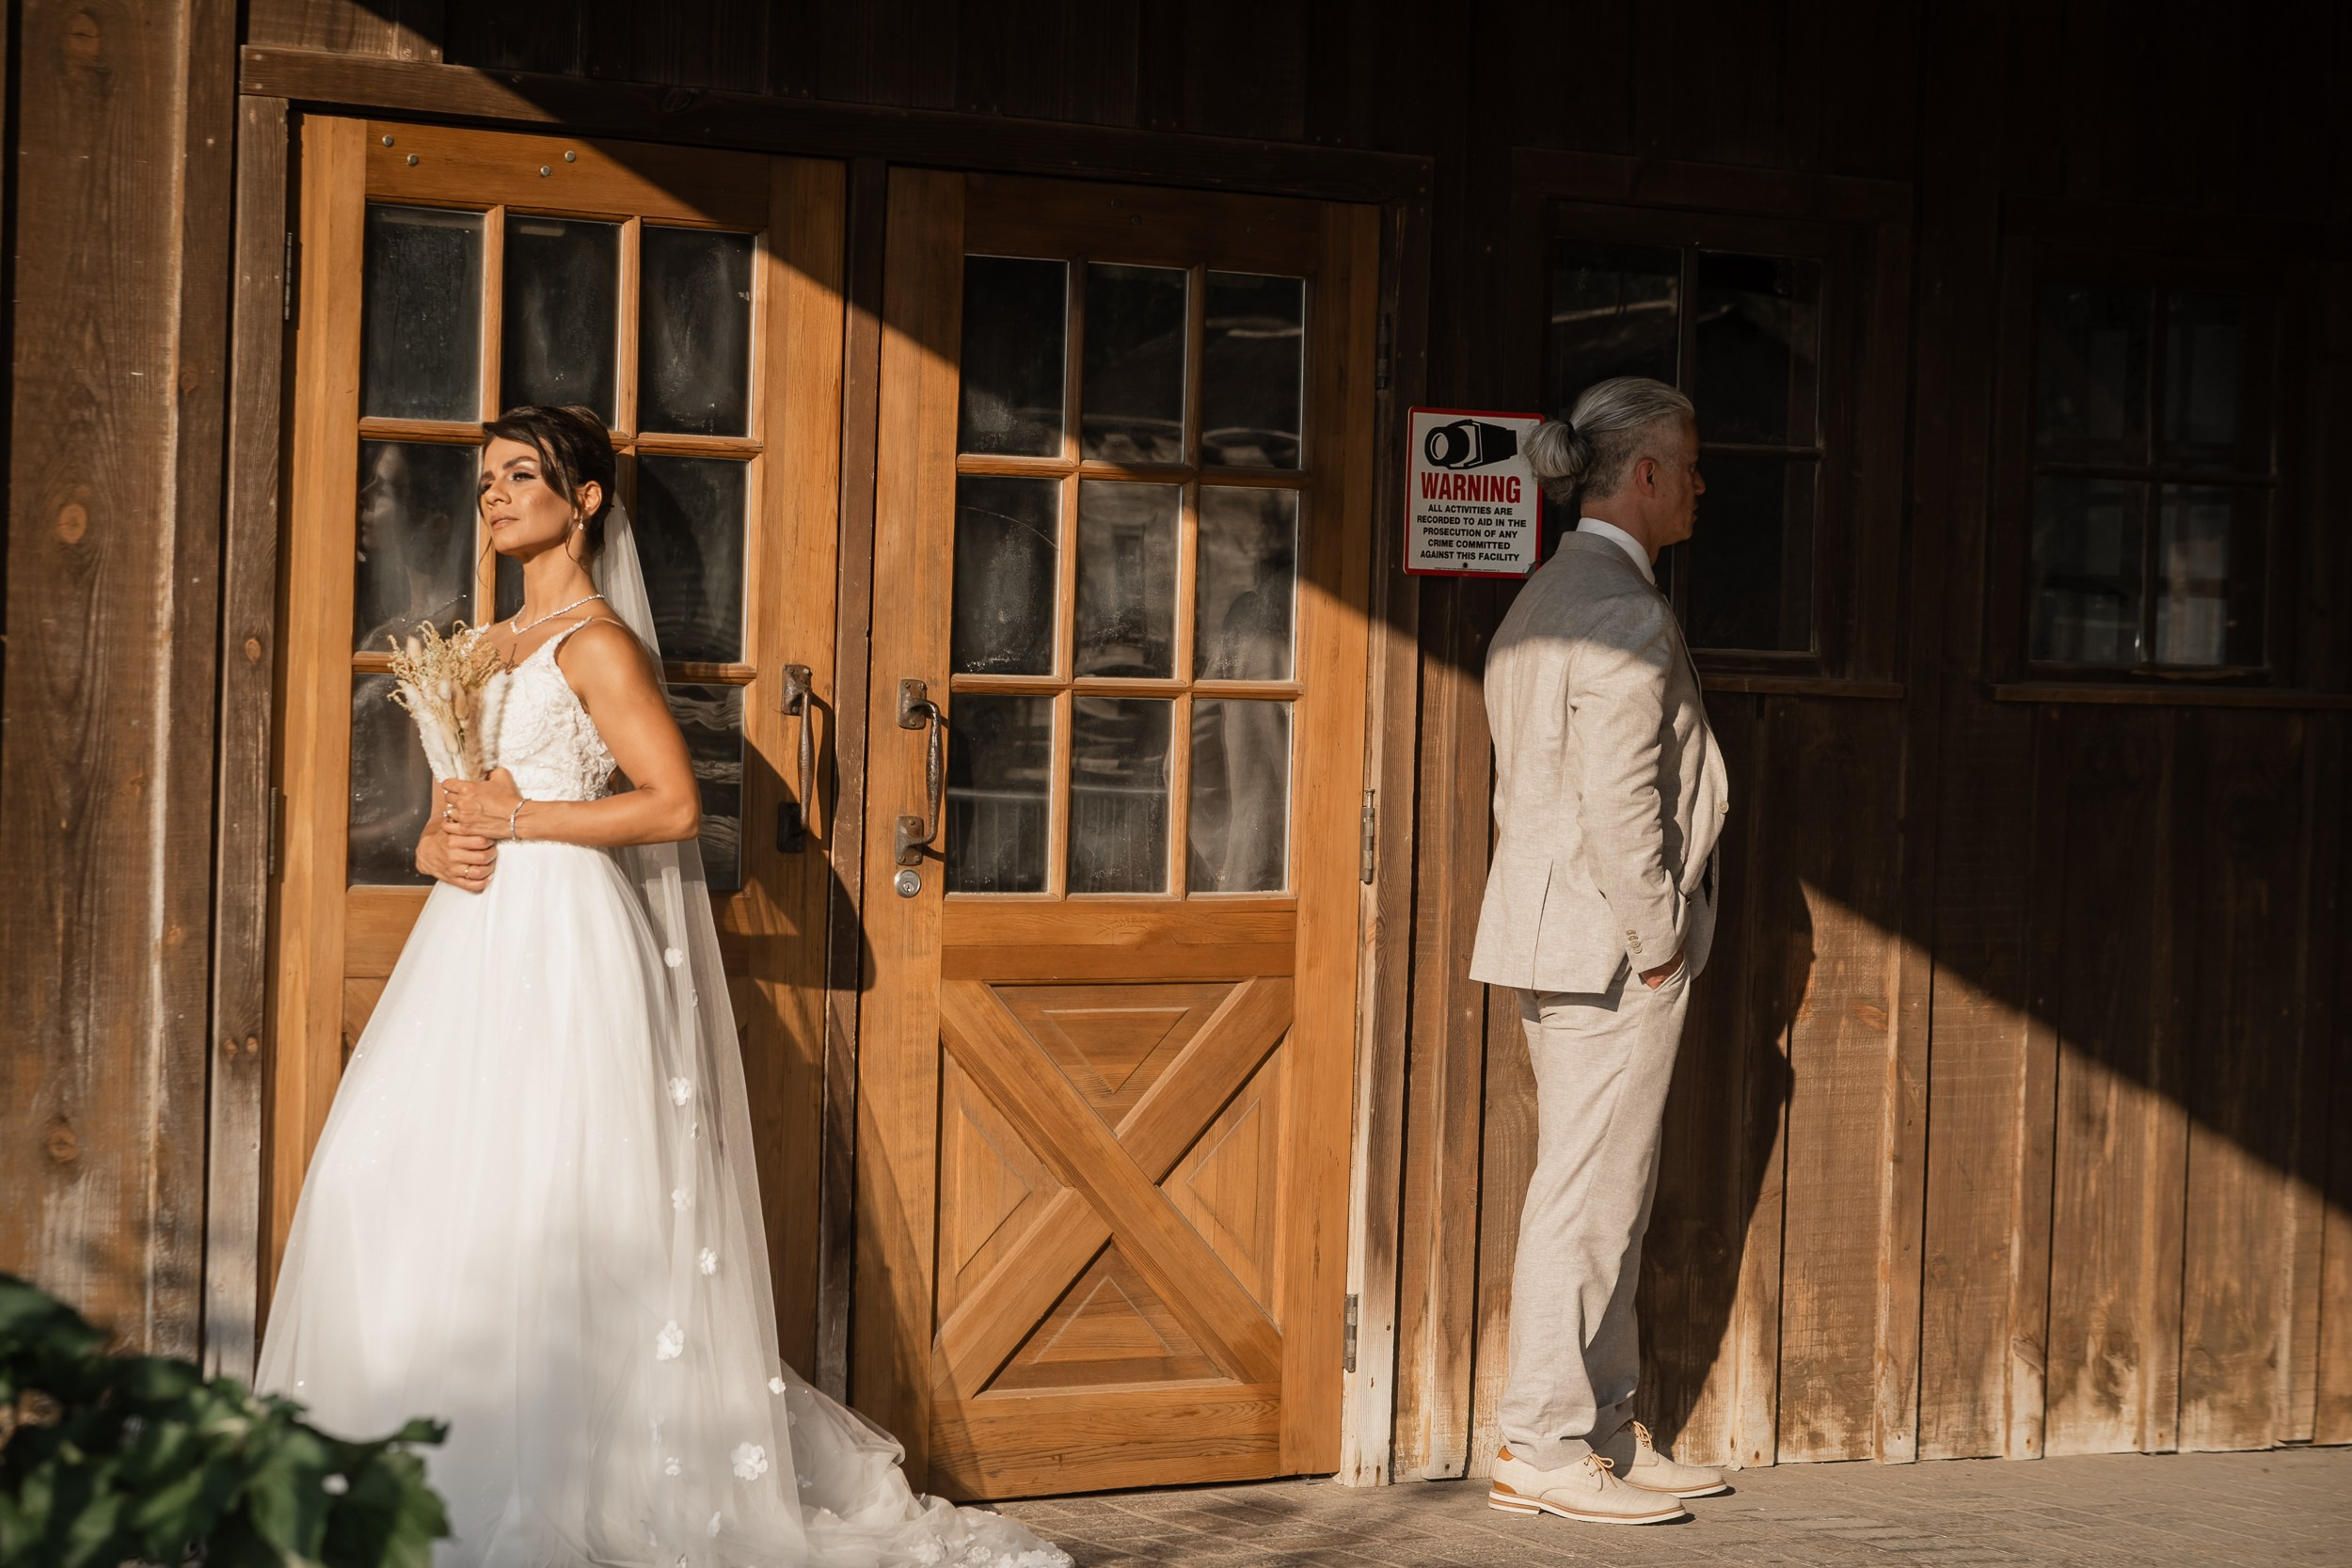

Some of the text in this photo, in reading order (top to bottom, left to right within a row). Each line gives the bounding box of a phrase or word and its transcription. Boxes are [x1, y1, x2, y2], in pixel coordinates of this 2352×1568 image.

[1421, 472, 1520, 503] WARNING
[1428, 504, 1442, 513] ALL
[1445, 505, 1491, 514] ACTIVITIES
[1417, 515, 1460, 524] RECORDED
[1423, 528, 1481, 536] PROSECUTION
[1428, 539, 1510, 549] CRIME COMMITTED
[1421, 551, 1454, 560] AGAINST
[1478, 553, 1519, 562] FACILITY
